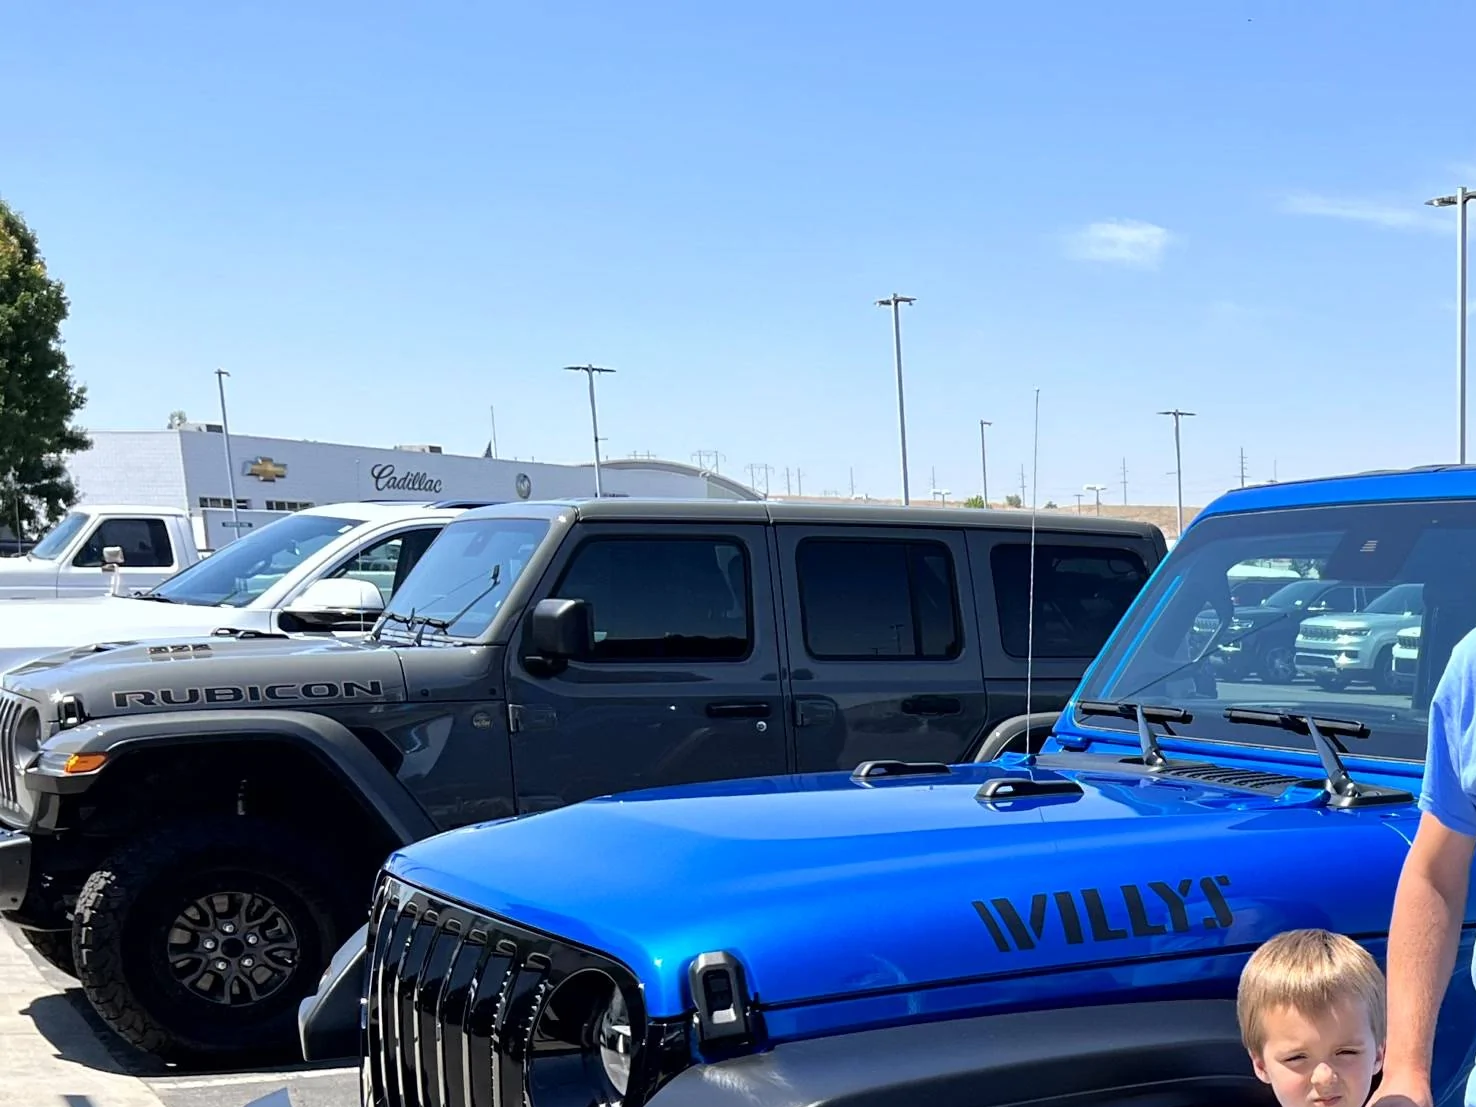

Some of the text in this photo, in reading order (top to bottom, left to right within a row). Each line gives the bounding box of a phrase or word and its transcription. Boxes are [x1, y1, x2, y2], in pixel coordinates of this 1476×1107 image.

[371, 463, 442, 493] Cadillac
[112, 680, 385, 708] RUBICON
[971, 875, 1232, 952] WILLYS
